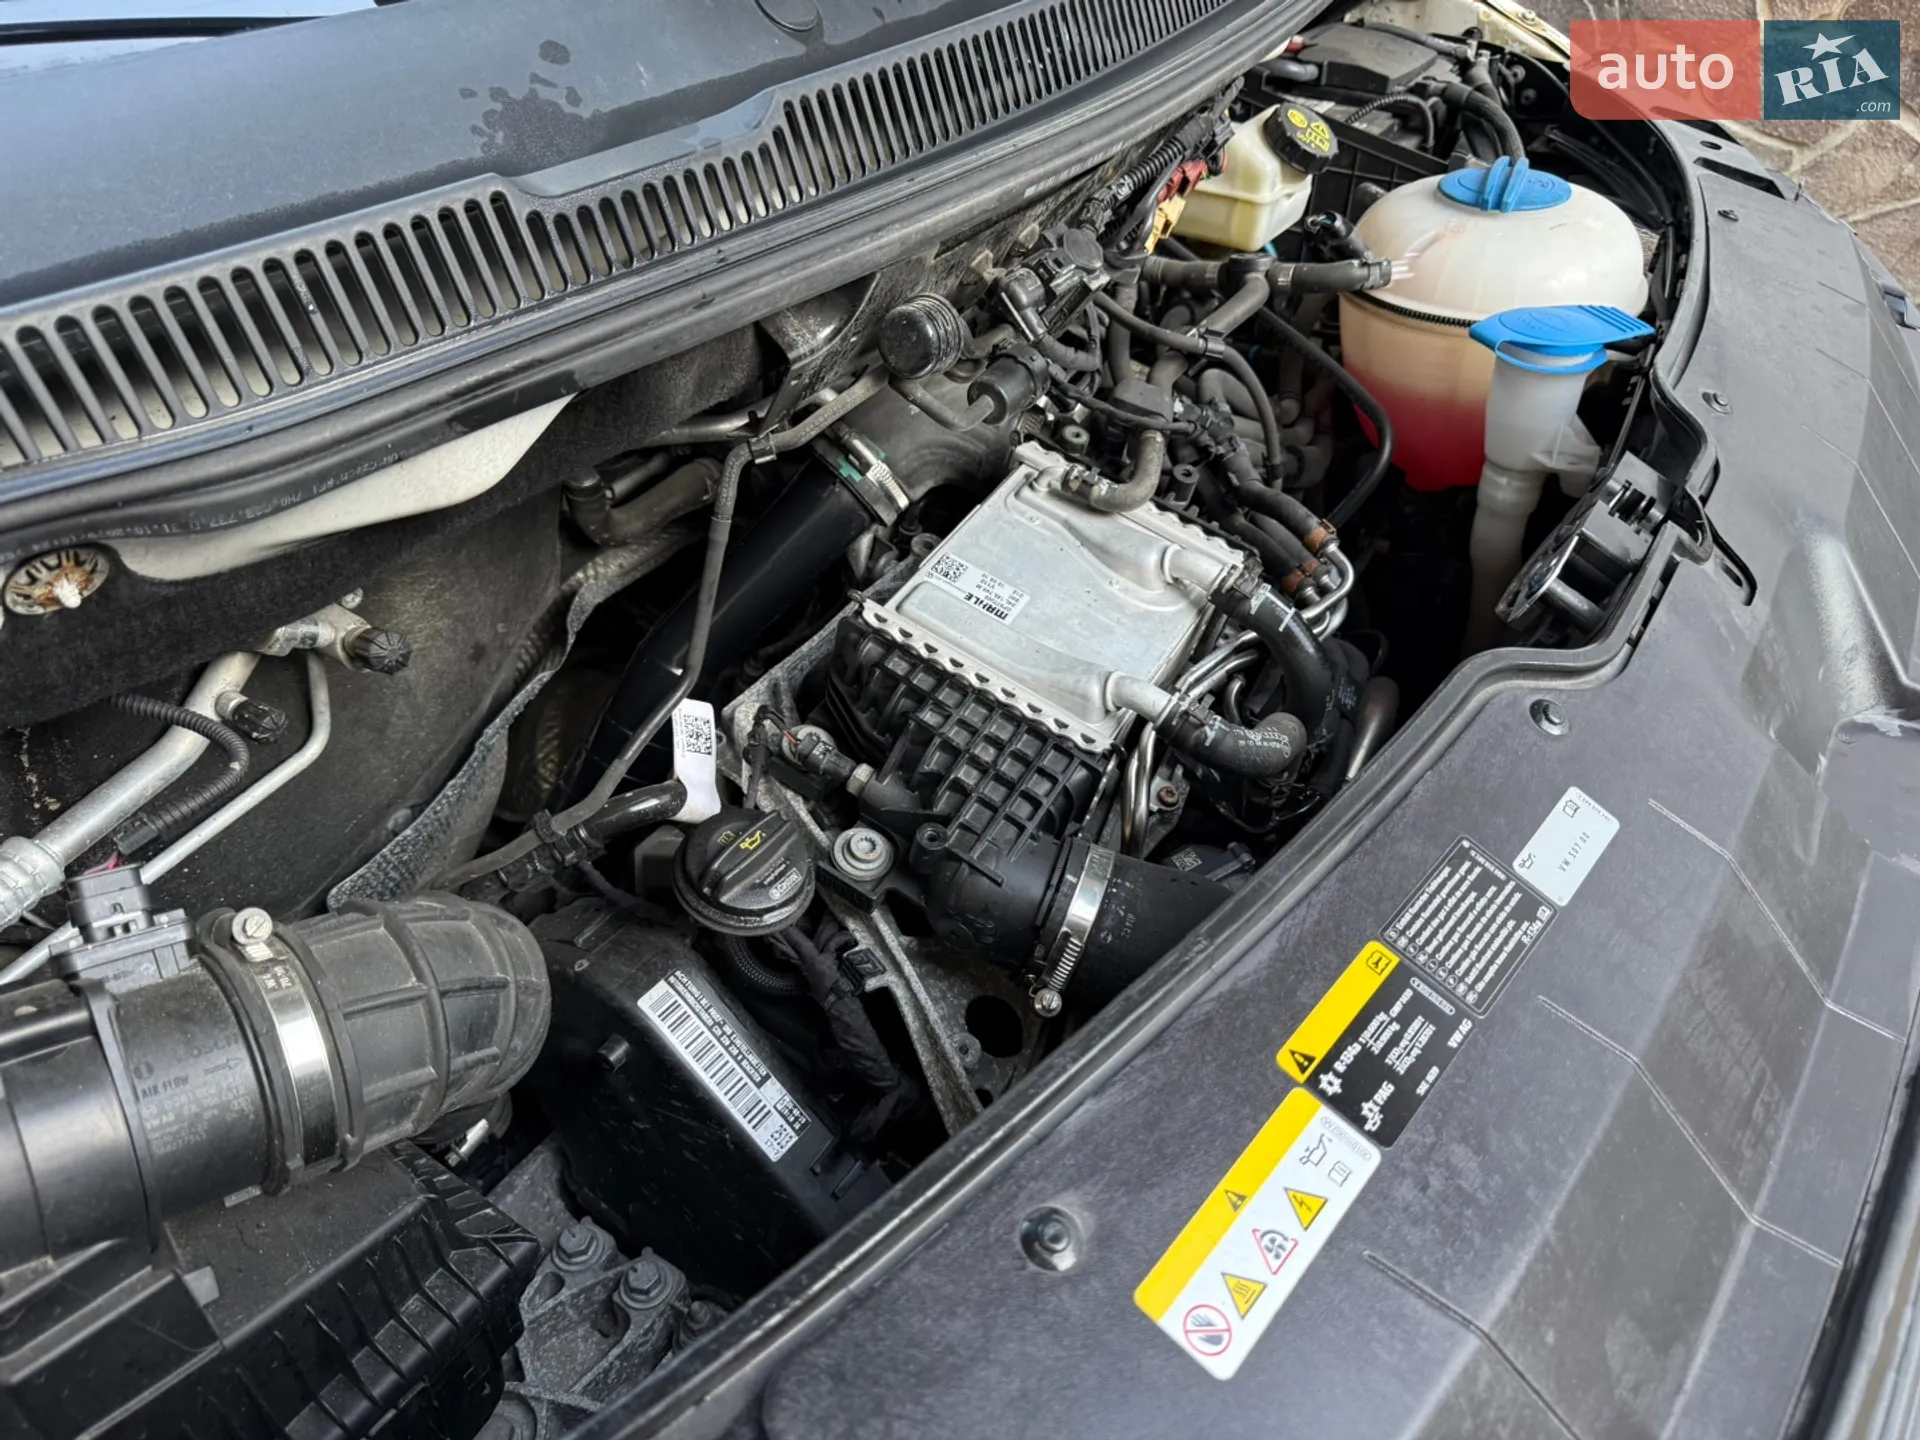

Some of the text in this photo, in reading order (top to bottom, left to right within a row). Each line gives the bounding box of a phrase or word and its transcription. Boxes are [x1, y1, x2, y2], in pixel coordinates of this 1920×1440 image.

[964, 591, 1009, 620] MAHLE
[1555, 856, 1571, 873] VW
[1567, 841, 1583, 859] 507
[1520, 918, 1543, 944] R-134a
[1332, 1039, 1362, 1075] R-134a
[139, 1084, 159, 1099] AIR
[1372, 1078, 1396, 1106] PAG
